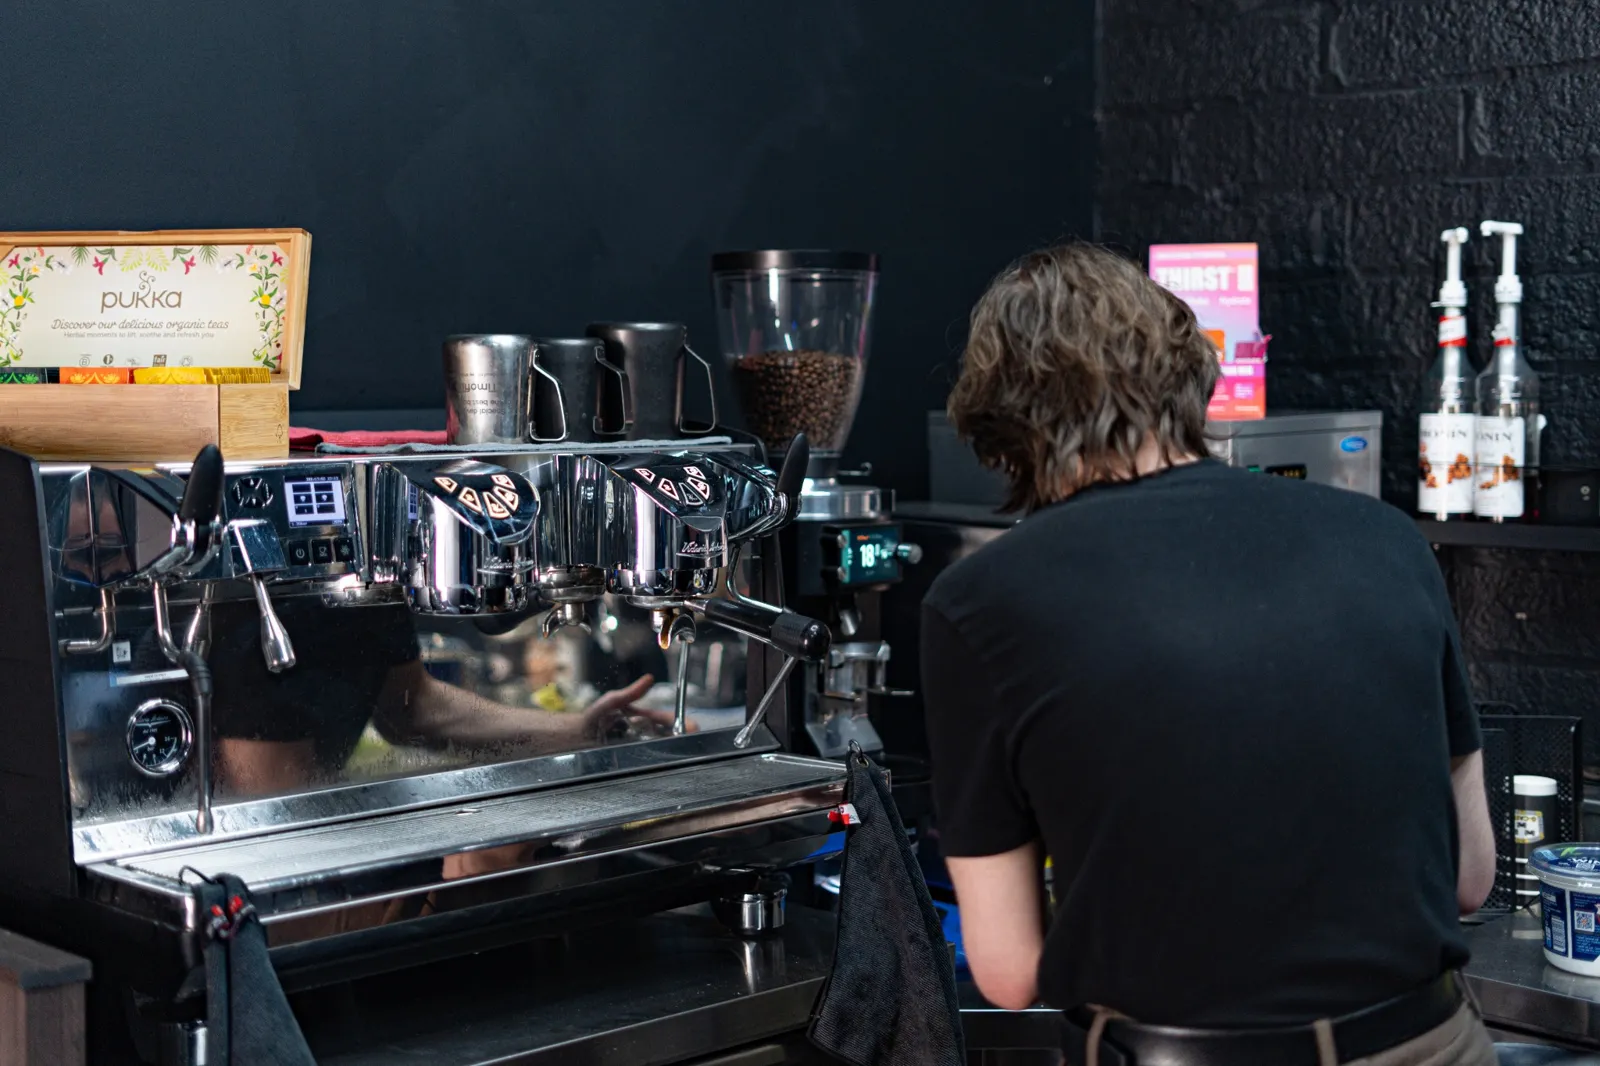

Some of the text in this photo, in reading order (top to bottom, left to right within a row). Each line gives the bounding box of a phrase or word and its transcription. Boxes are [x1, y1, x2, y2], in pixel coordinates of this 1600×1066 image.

[101, 271, 182, 314] pukka
[51, 318, 230, 331] Discover our delicious organic teas
